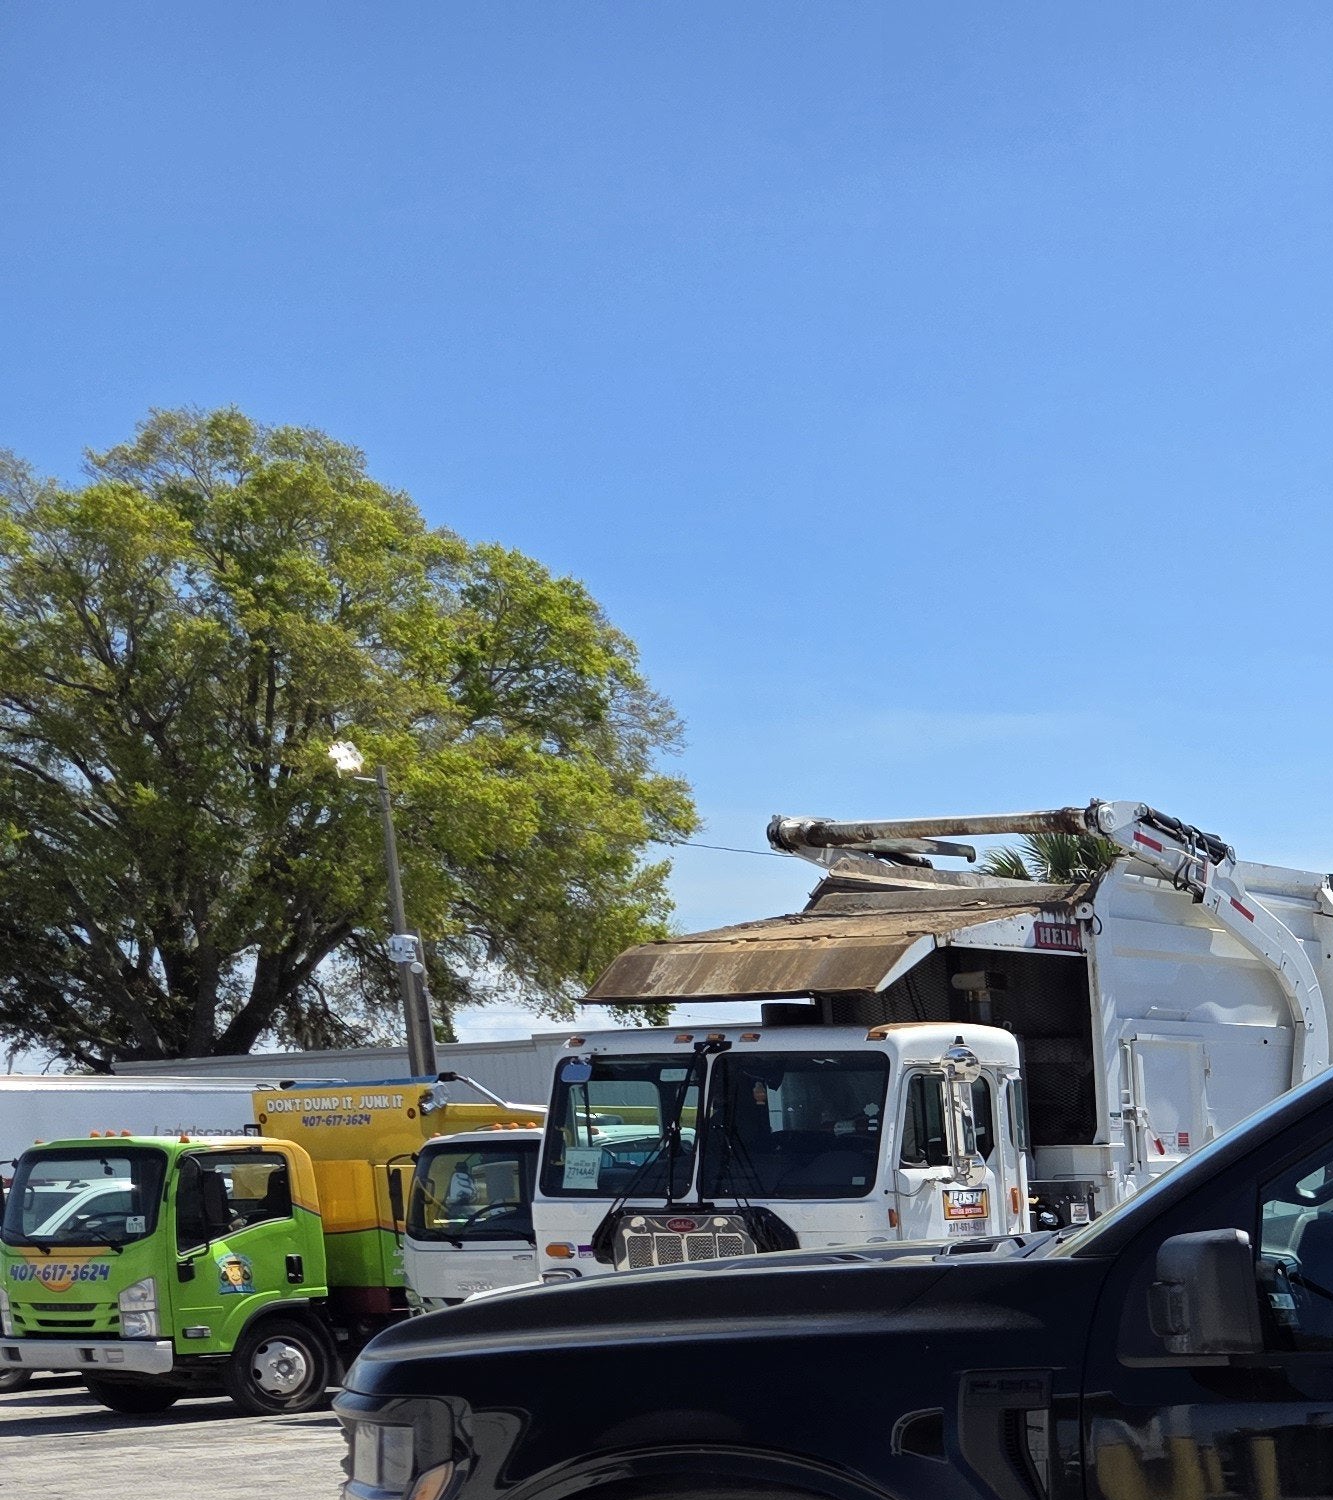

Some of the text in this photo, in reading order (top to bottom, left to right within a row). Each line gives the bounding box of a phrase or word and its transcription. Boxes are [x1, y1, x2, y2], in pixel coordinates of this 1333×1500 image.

[267, 1098, 301, 1113] DON'T
[304, 1096, 340, 1111] DUMP
[359, 1094, 390, 1110] JUNK
[391, 1094, 403, 1109] IT
[302, 1114, 372, 1127] 407-617-3624
[9, 1263, 111, 1281] 407-617-3624
